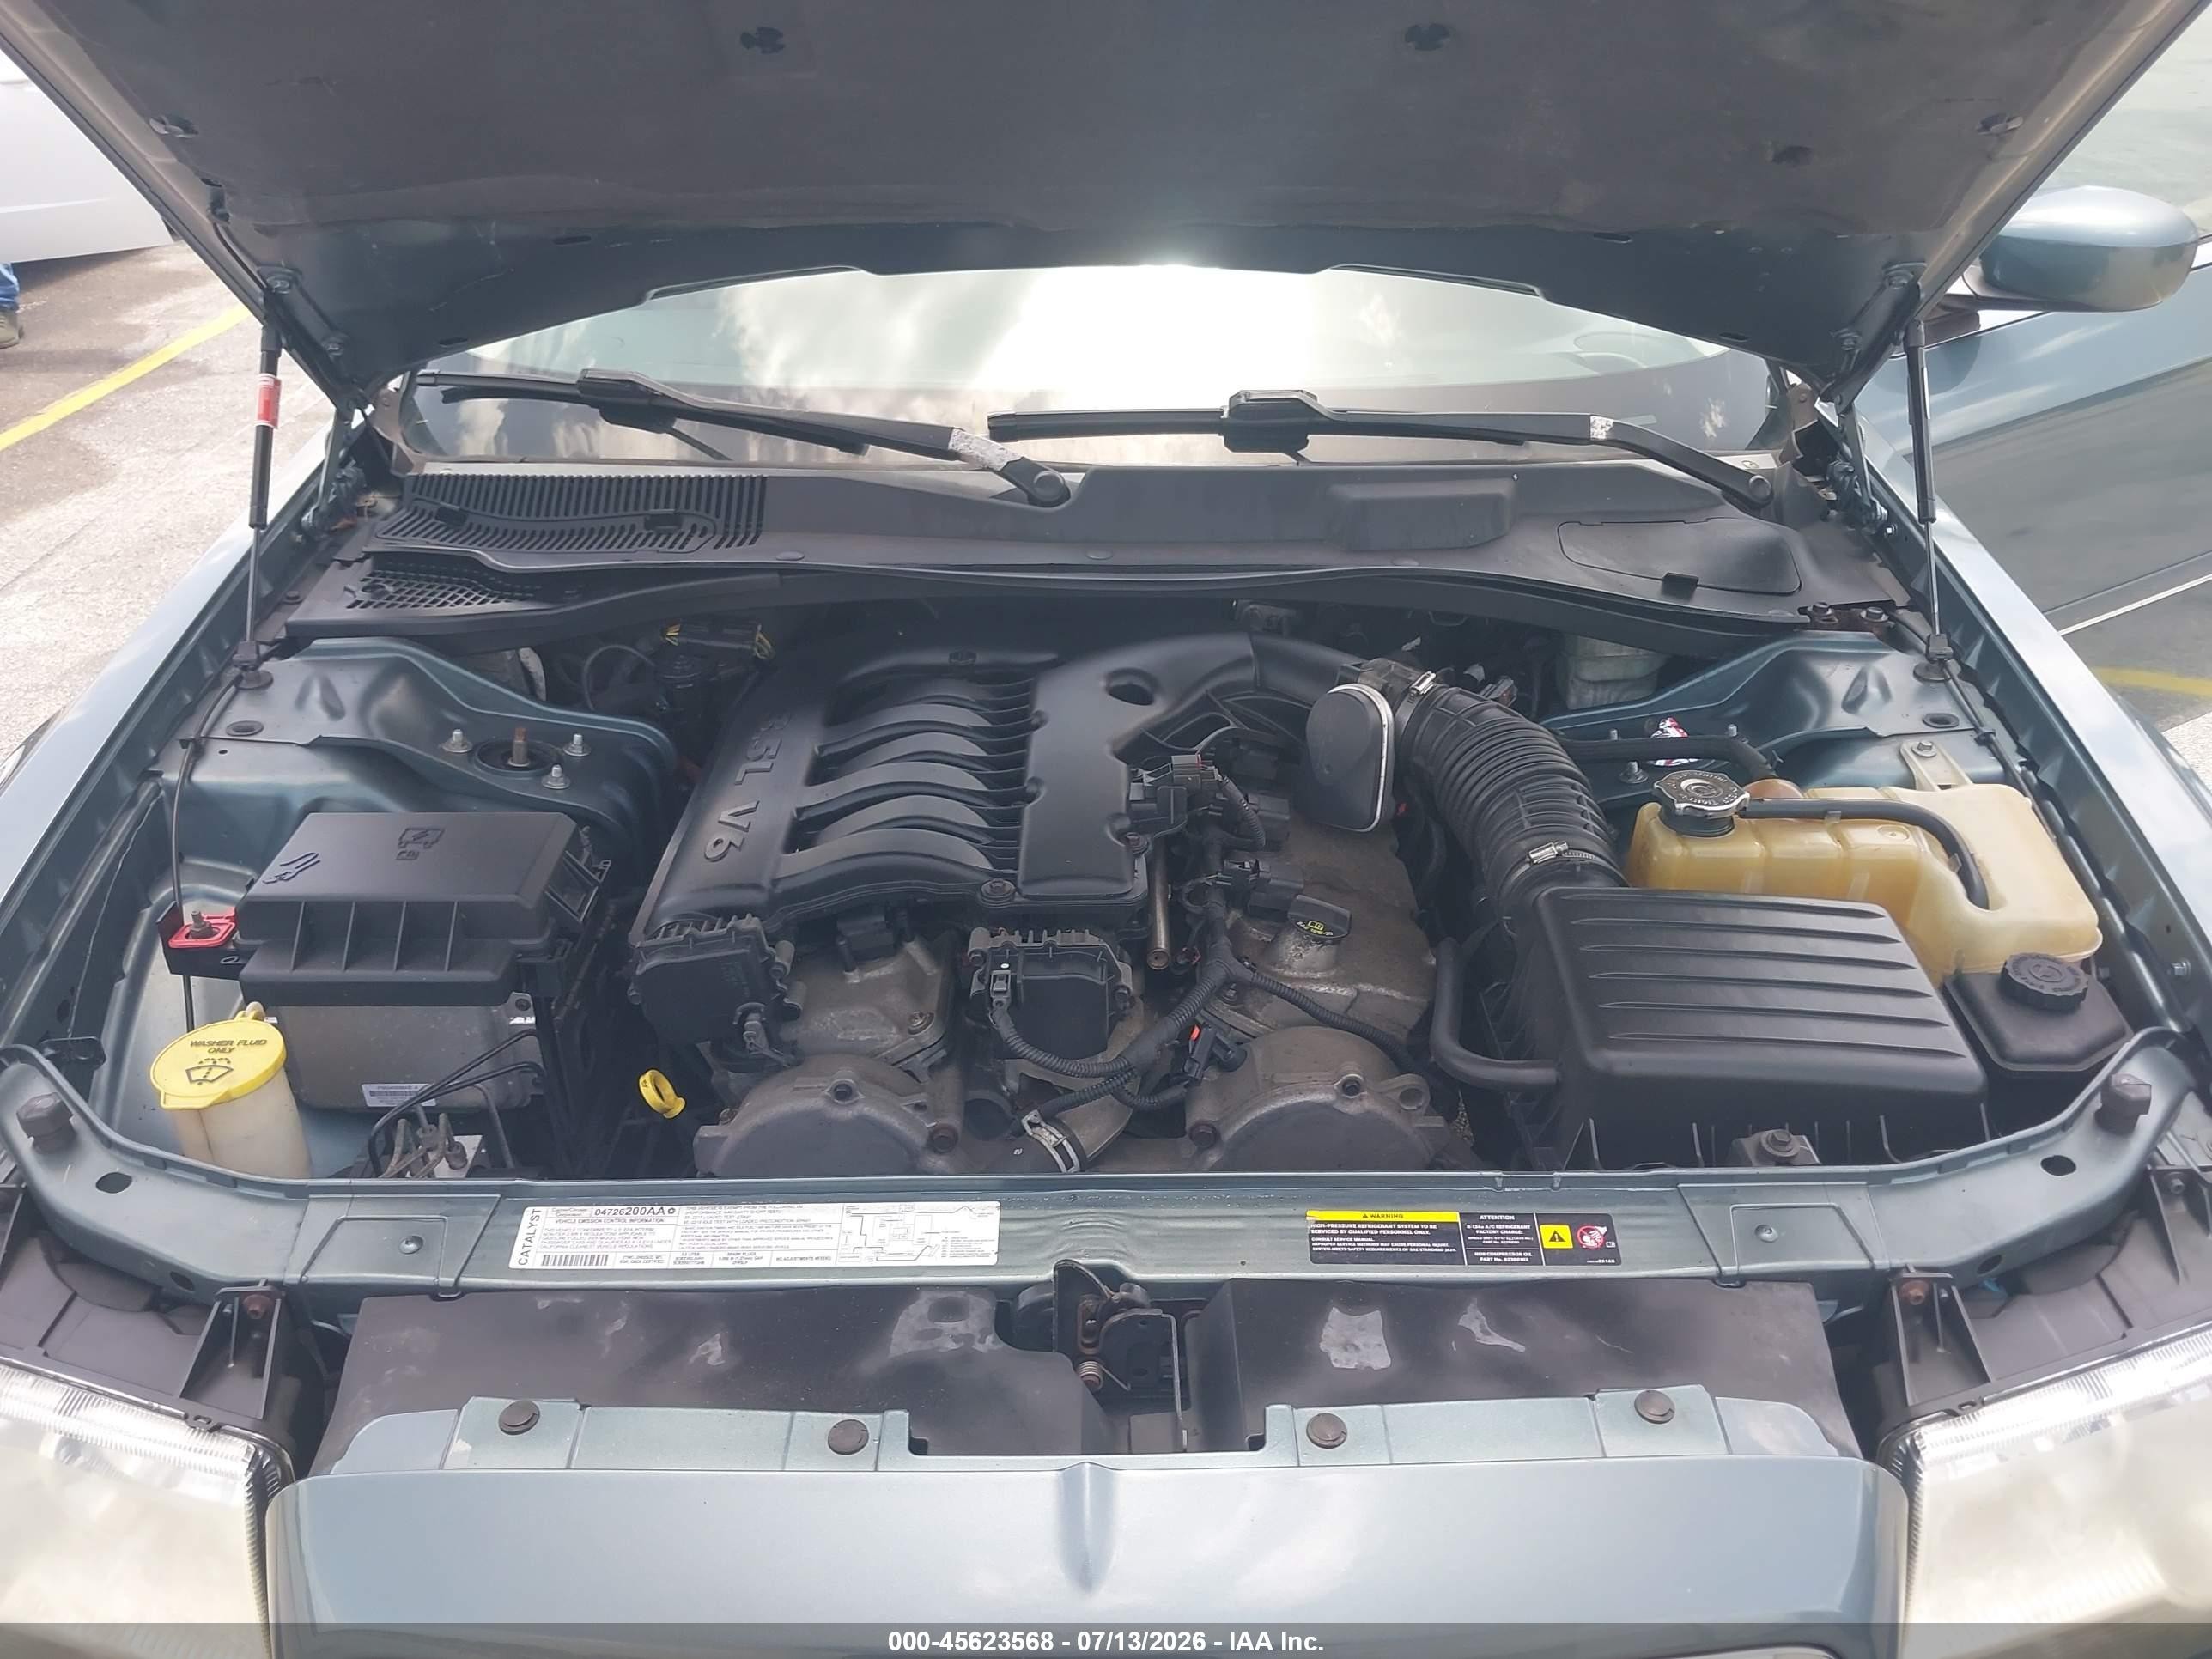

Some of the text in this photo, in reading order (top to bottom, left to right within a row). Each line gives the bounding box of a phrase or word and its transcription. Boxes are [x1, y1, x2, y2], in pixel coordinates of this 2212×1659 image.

[704, 800, 760, 863] V6
[517, 1208, 543, 1266] CATALYST
[594, 1206, 665, 1217] 04726200AA
